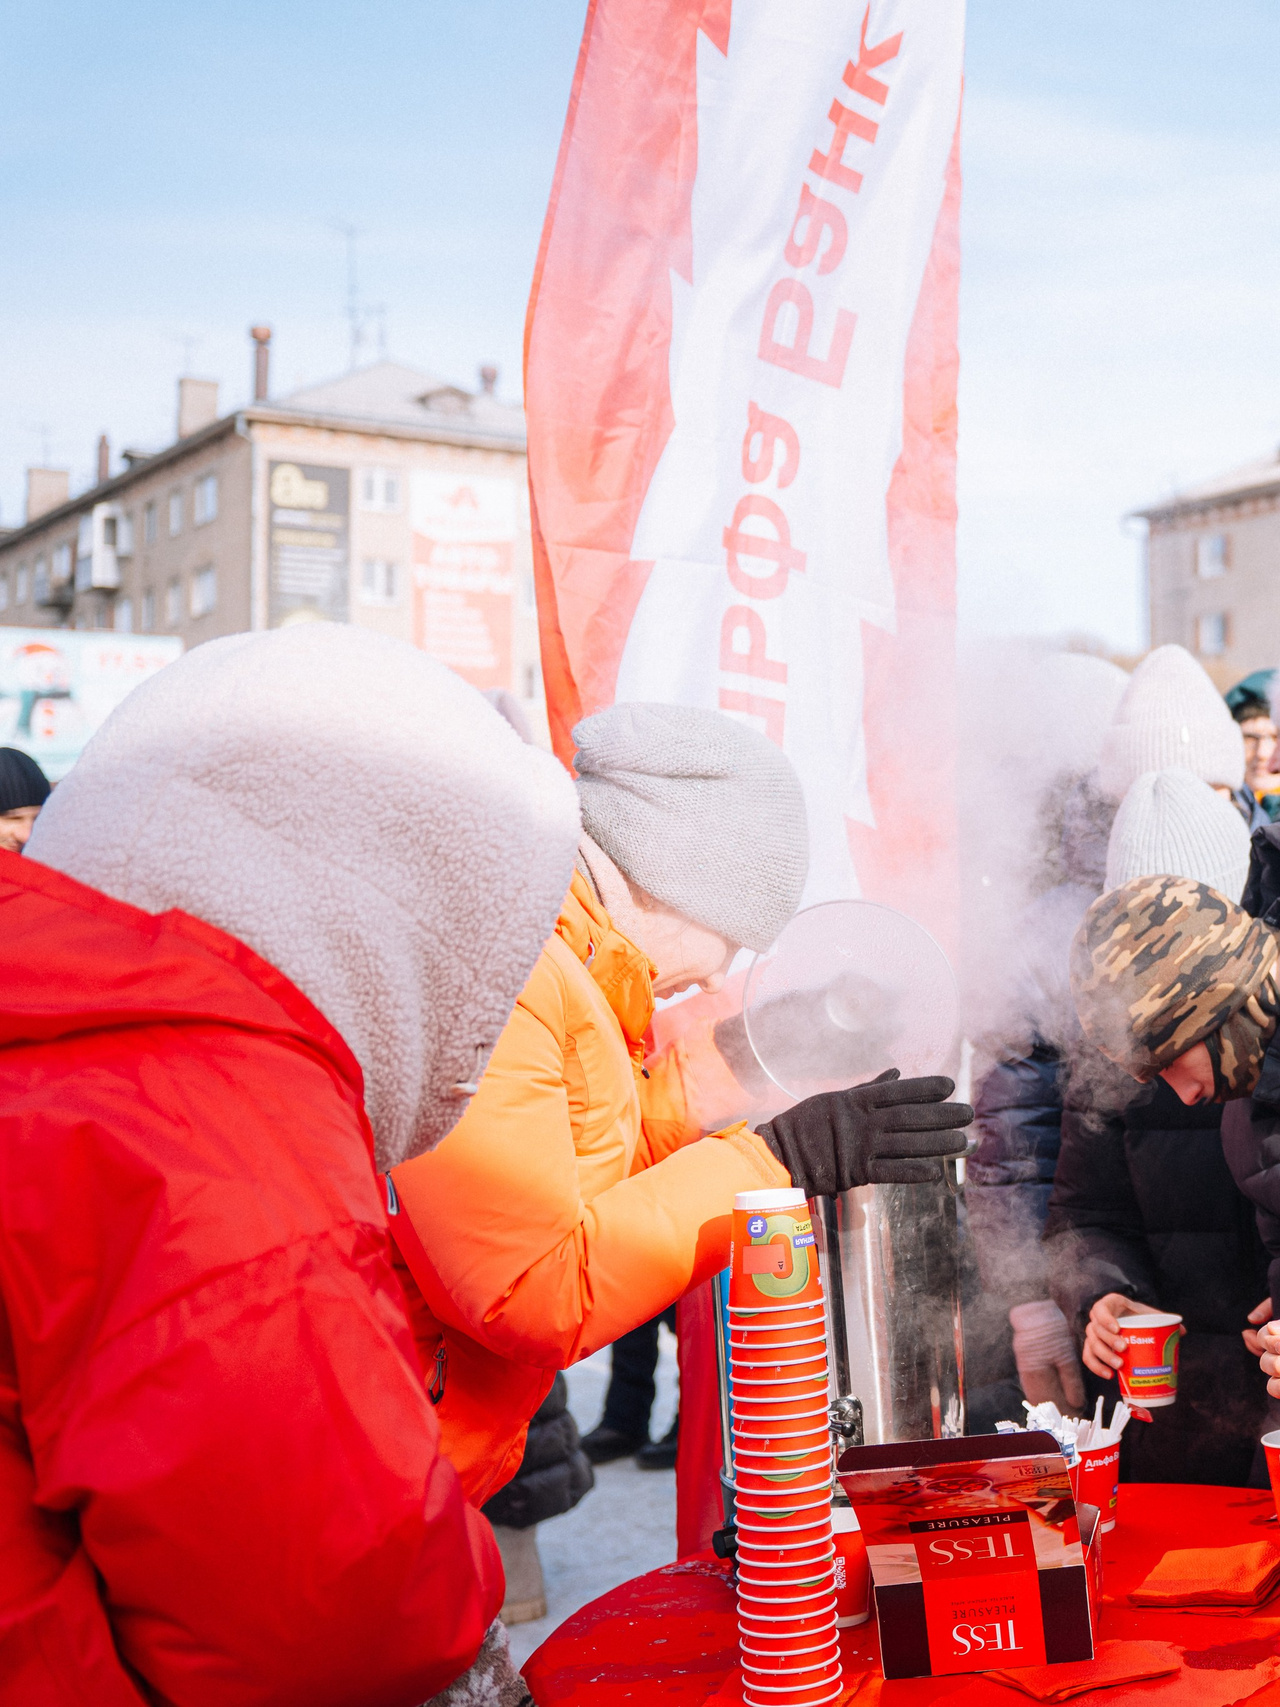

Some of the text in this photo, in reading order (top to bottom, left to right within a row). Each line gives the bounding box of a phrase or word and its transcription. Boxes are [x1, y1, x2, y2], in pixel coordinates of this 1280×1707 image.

[1129, 1335, 1155, 1345] Банк
[1084, 1454, 1114, 1468] Альфа
[927, 1514, 1012, 1530] PLEASURE
[928, 1532, 1024, 1565] TESS
[952, 1604, 1017, 1620] PLEASURE
[951, 1619, 1024, 1656] TESS
